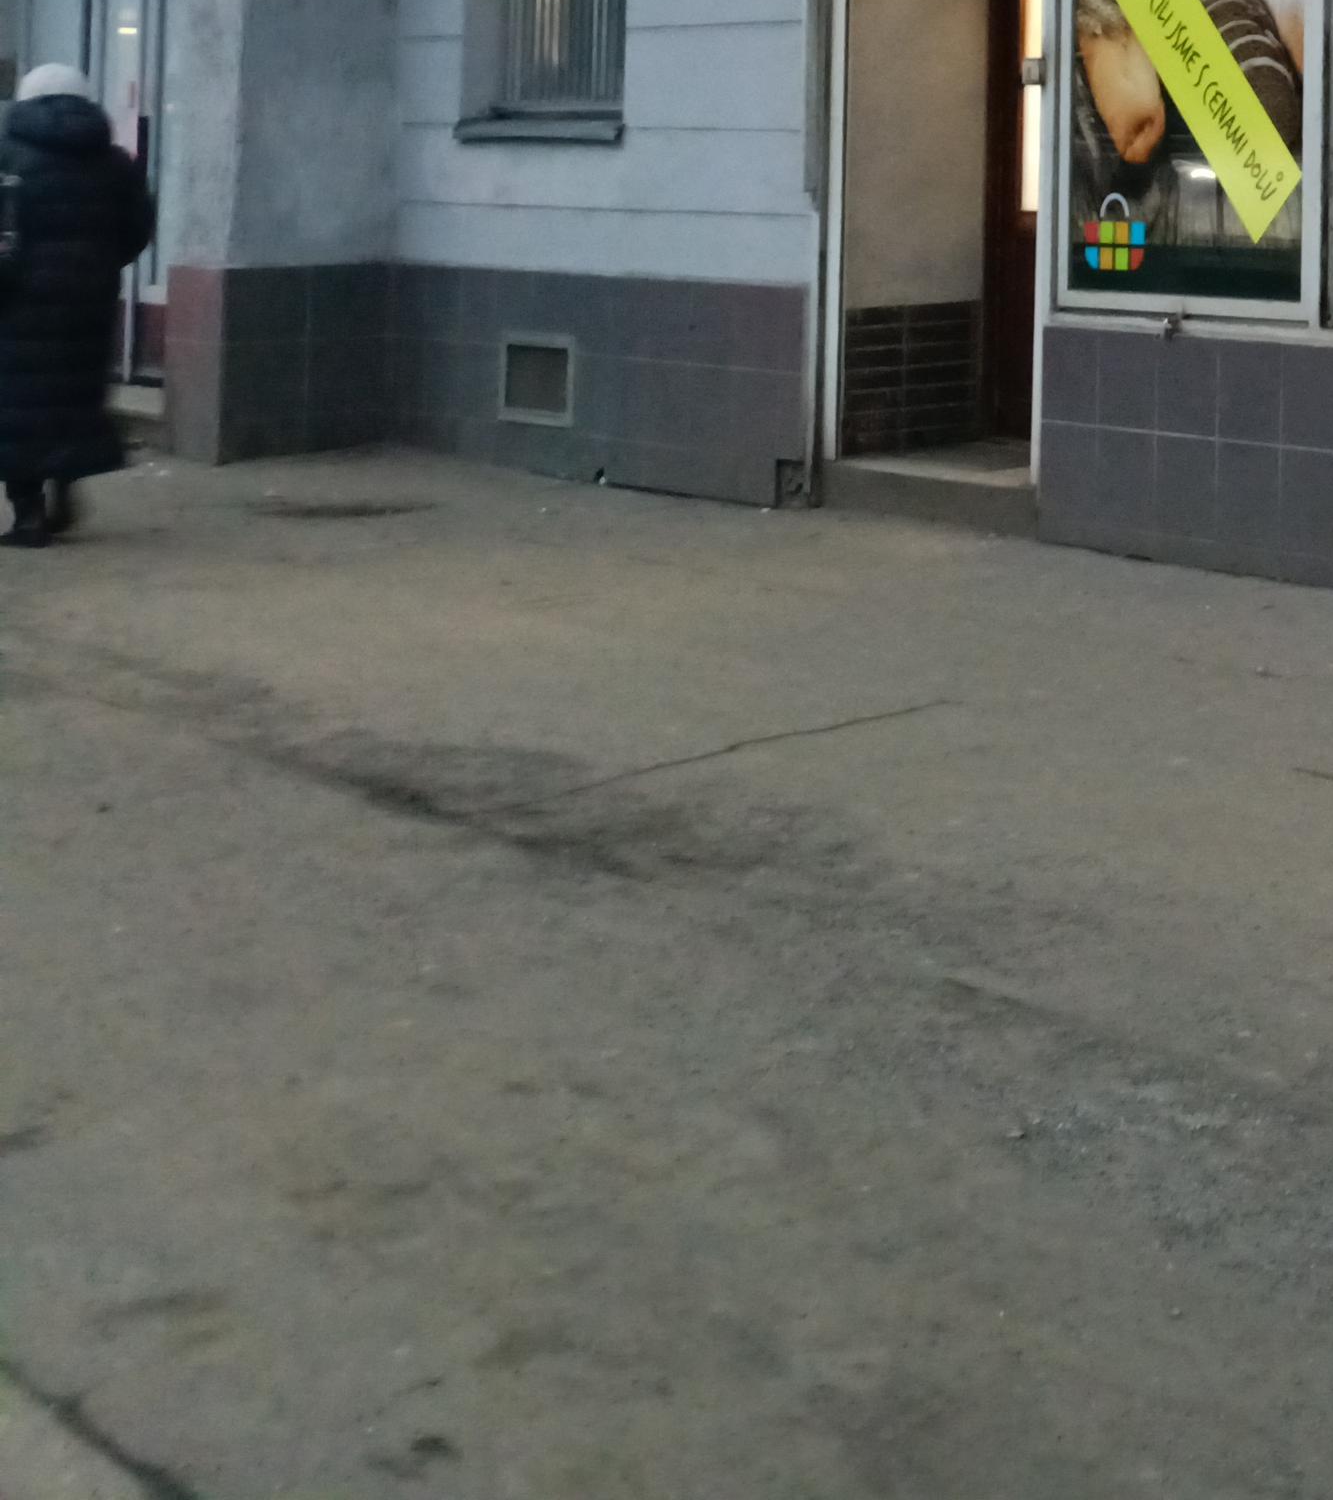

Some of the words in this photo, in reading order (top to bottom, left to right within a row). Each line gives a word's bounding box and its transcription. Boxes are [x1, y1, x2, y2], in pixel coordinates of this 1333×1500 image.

[1166, 22, 1199, 72] JSME
[1194, 65, 1210, 87] S
[1203, 80, 1248, 155] CENAMI
[1244, 149, 1284, 201] DOLŮ
